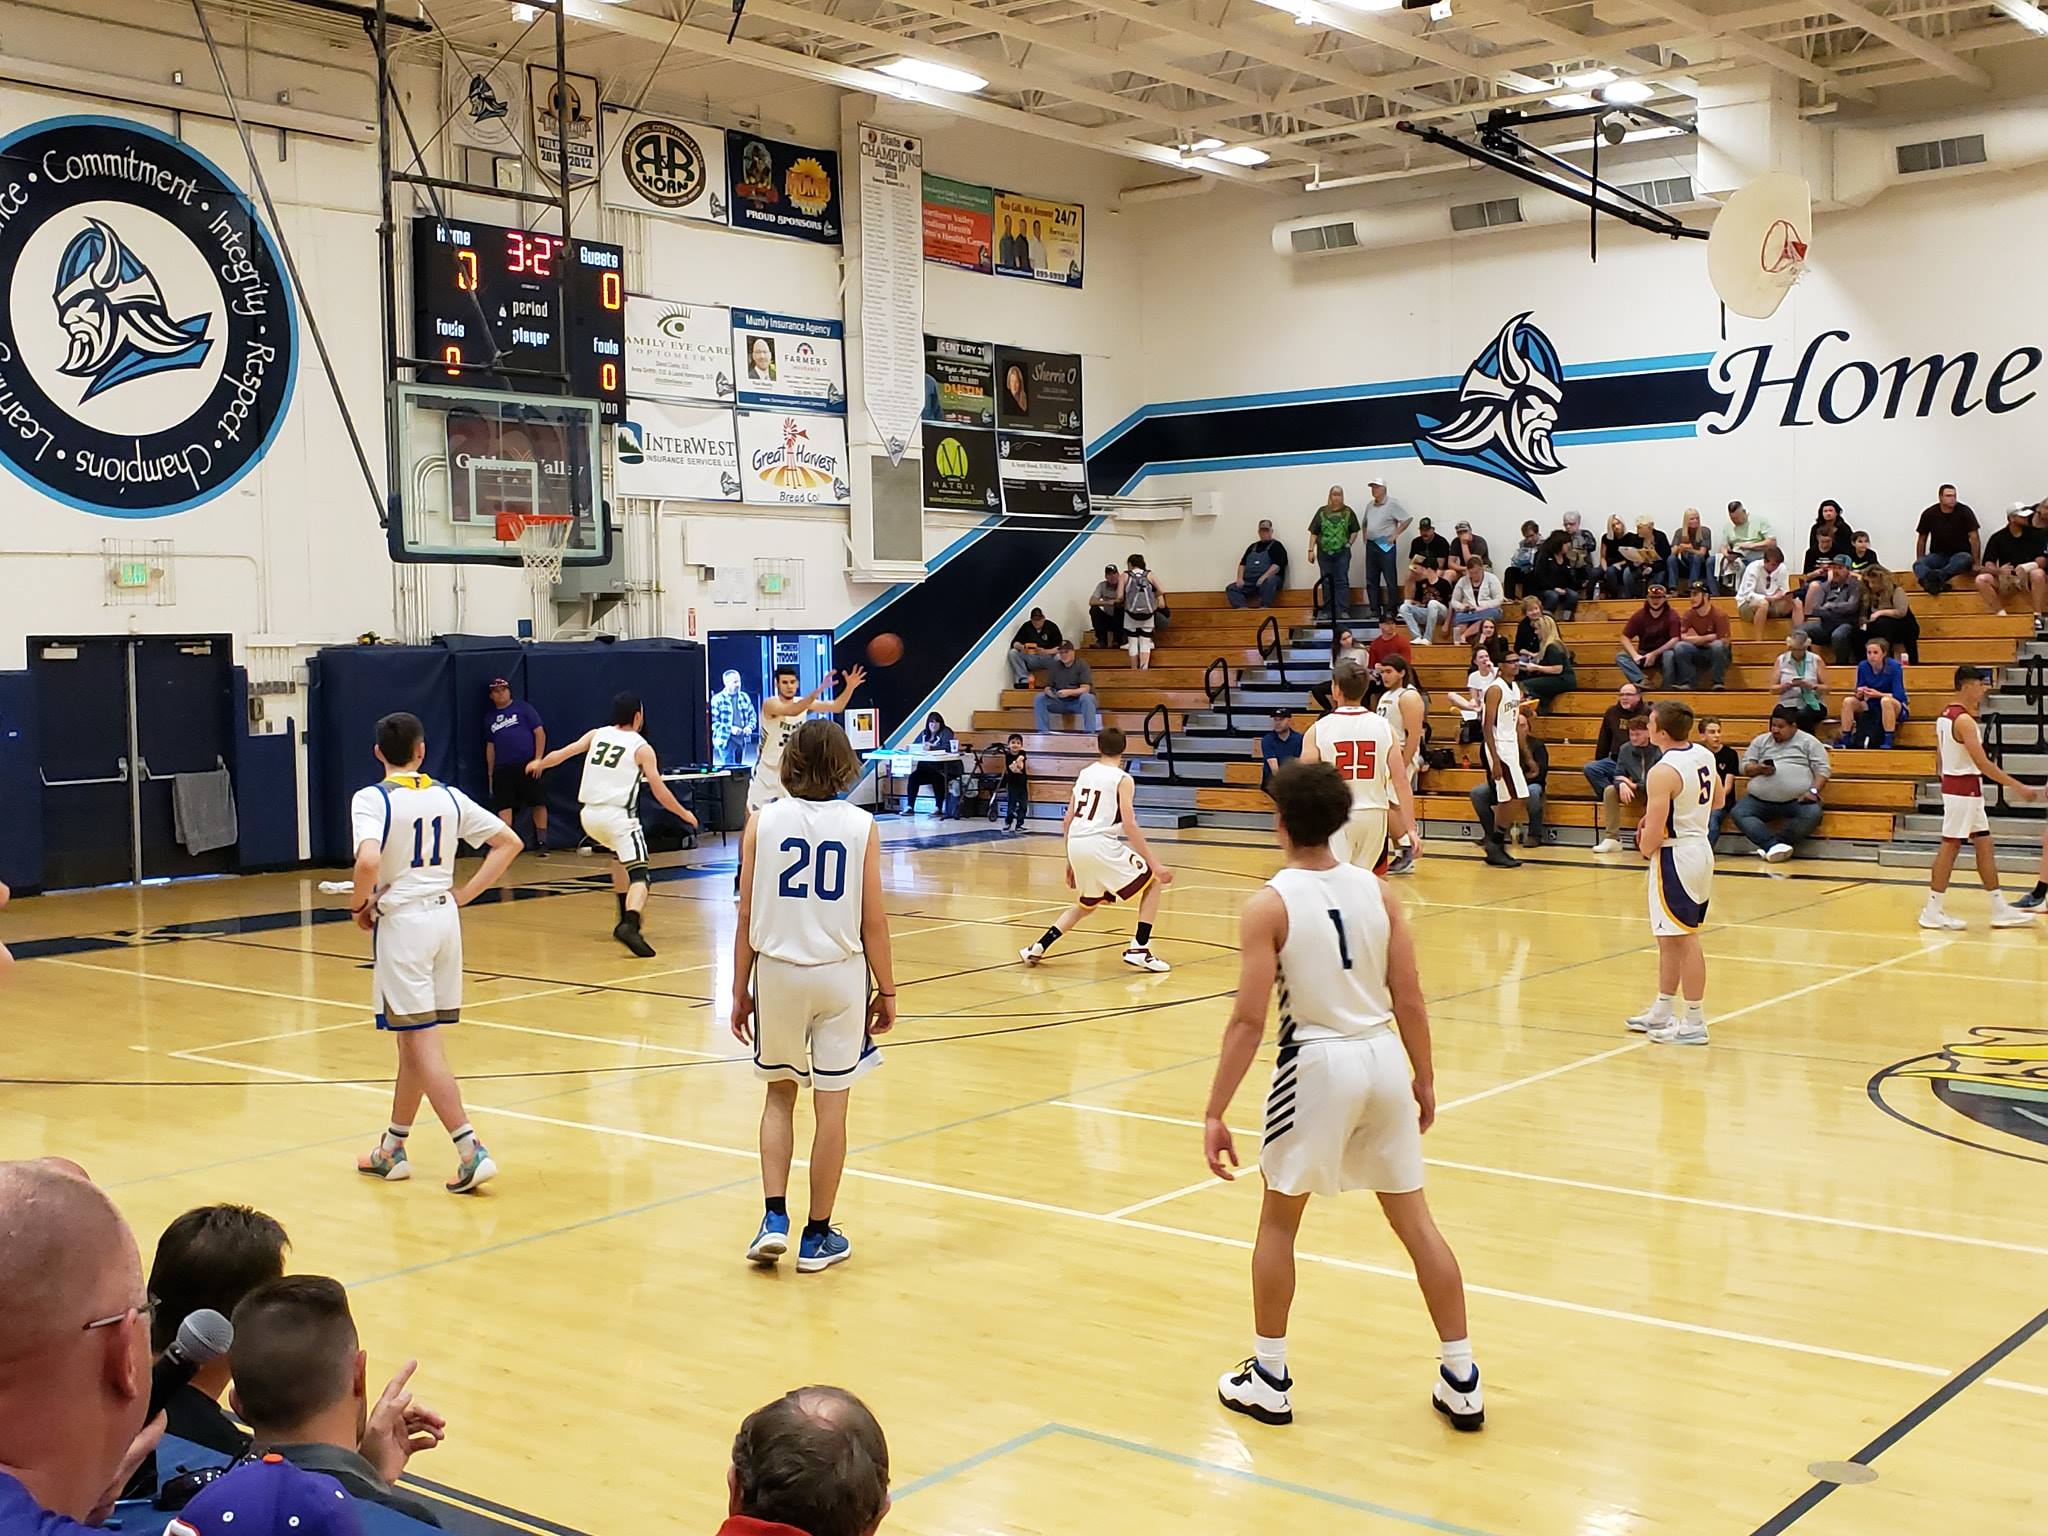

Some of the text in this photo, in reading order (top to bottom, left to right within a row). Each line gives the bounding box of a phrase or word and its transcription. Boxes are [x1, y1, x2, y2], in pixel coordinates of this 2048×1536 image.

[539, 137, 560, 149] FIELD
[567, 143, 591, 156] OCKEY
[861, 142, 922, 168] CHAMPIONS
[568, 155, 592, 169] 2012
[43, 146, 201, 206] Commitment
[643, 174, 689, 194] HORN
[746, 209, 824, 231] PROUD SPONSORS
[1054, 207, 1077, 226] 24/7
[208, 210, 270, 316] Integrity
[507, 232, 564, 276] 3:2
[580, 246, 619, 268] Guests
[602, 272, 621, 310] 0
[512, 301, 549, 318] period
[512, 327, 550, 347] player
[746, 314, 832, 337] Munly Insurance Agency
[625, 337, 731, 356] AMILY EYE CARE
[635, 347, 715, 364] OPTOMETRY
[940, 341, 976, 354] CENTURY
[784, 354, 828, 367] FARMERS
[602, 363, 617, 391] 0
[1707, 330, 2043, 435] Home
[218, 340, 276, 443] Respect
[76, 439, 212, 494] Champions
[646, 455, 684, 465] INSURANCE
[723, 458, 736, 468] LLC
[752, 444, 838, 475] Great Harvest
[779, 490, 805, 502] Bread
[591, 742, 626, 768] 33
[1334, 740, 1376, 780] 25
[1697, 765, 1712, 805] 5
[1074, 788, 1102, 821] 21
[411, 815, 443, 868] 11
[779, 837, 847, 901] 20
[1328, 908, 1353, 969] 1
